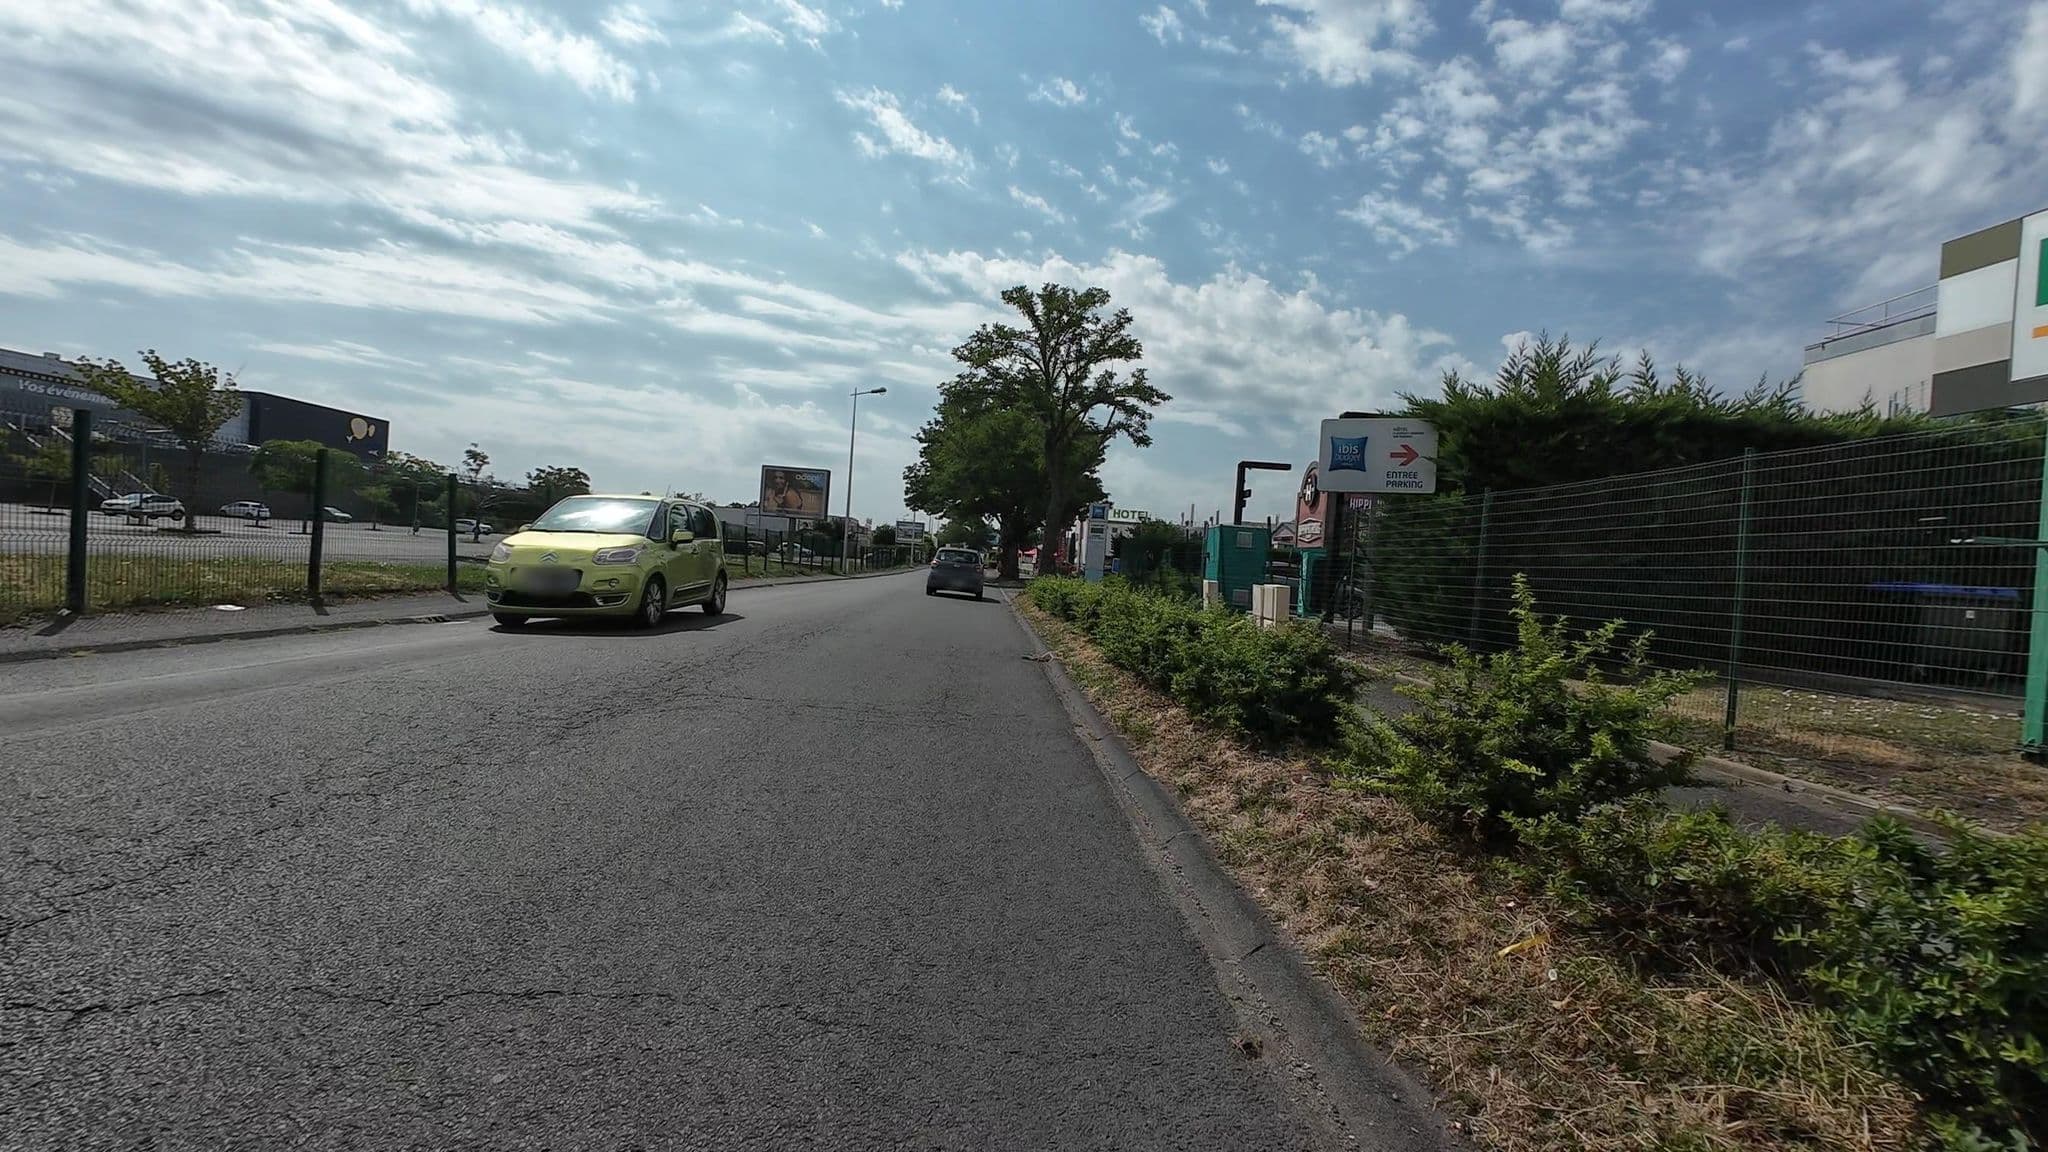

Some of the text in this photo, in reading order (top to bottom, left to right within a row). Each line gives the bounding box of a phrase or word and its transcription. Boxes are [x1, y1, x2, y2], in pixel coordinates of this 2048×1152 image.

[1338, 444, 1359, 454] ibis
[1386, 470, 1418, 479] ENTREE
[1386, 480, 1423, 488] PARKING
